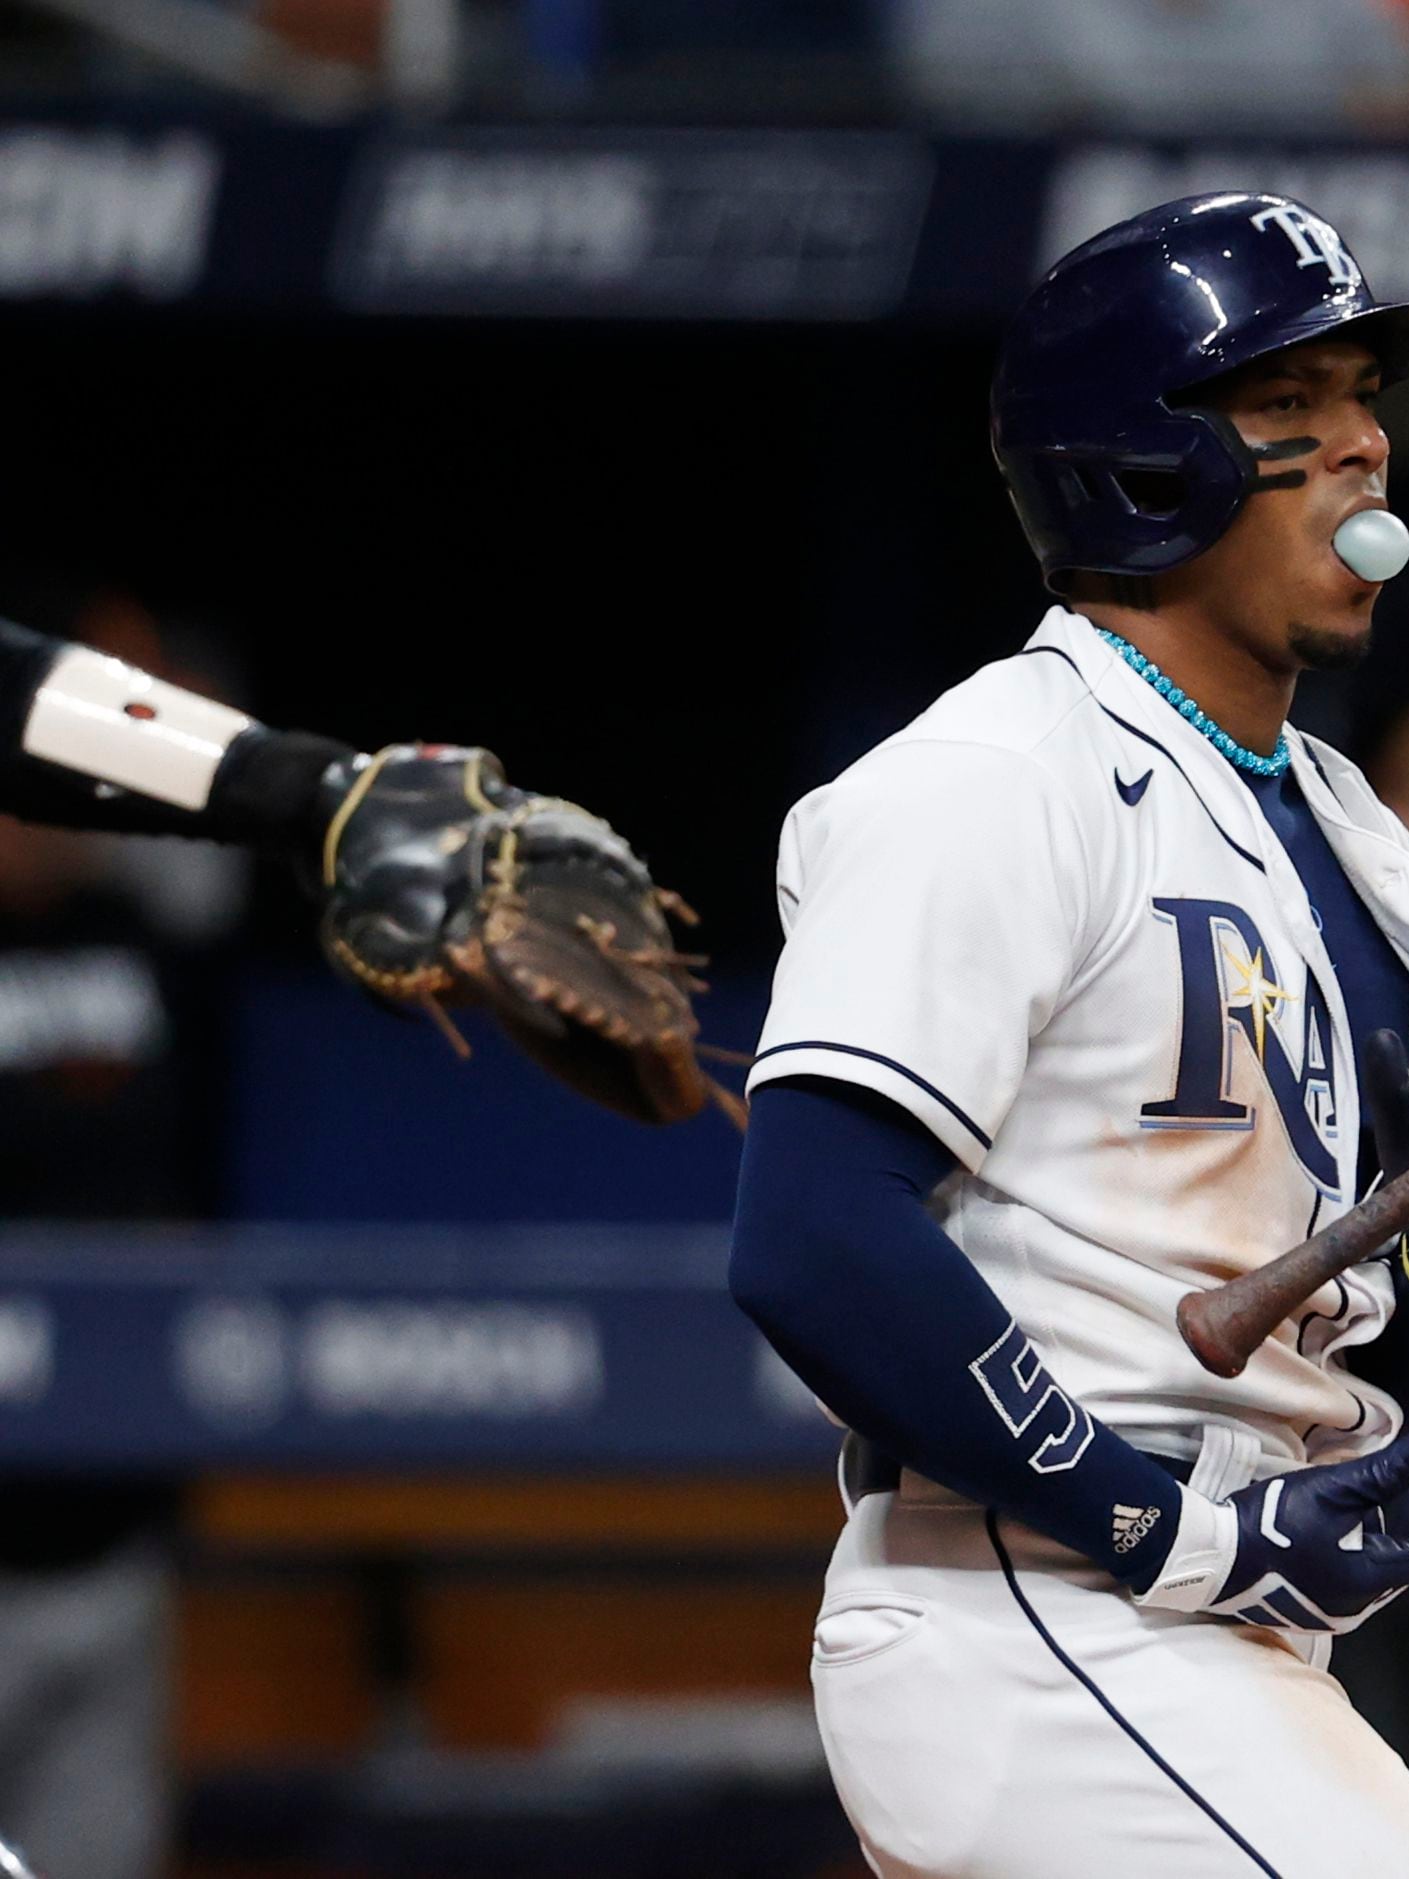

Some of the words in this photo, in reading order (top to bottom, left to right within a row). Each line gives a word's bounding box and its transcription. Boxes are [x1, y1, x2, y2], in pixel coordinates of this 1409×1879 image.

[1249, 204, 1361, 287] TB
[968, 1318, 1095, 1474] 5
[1114, 1506, 1161, 1553] adidas
